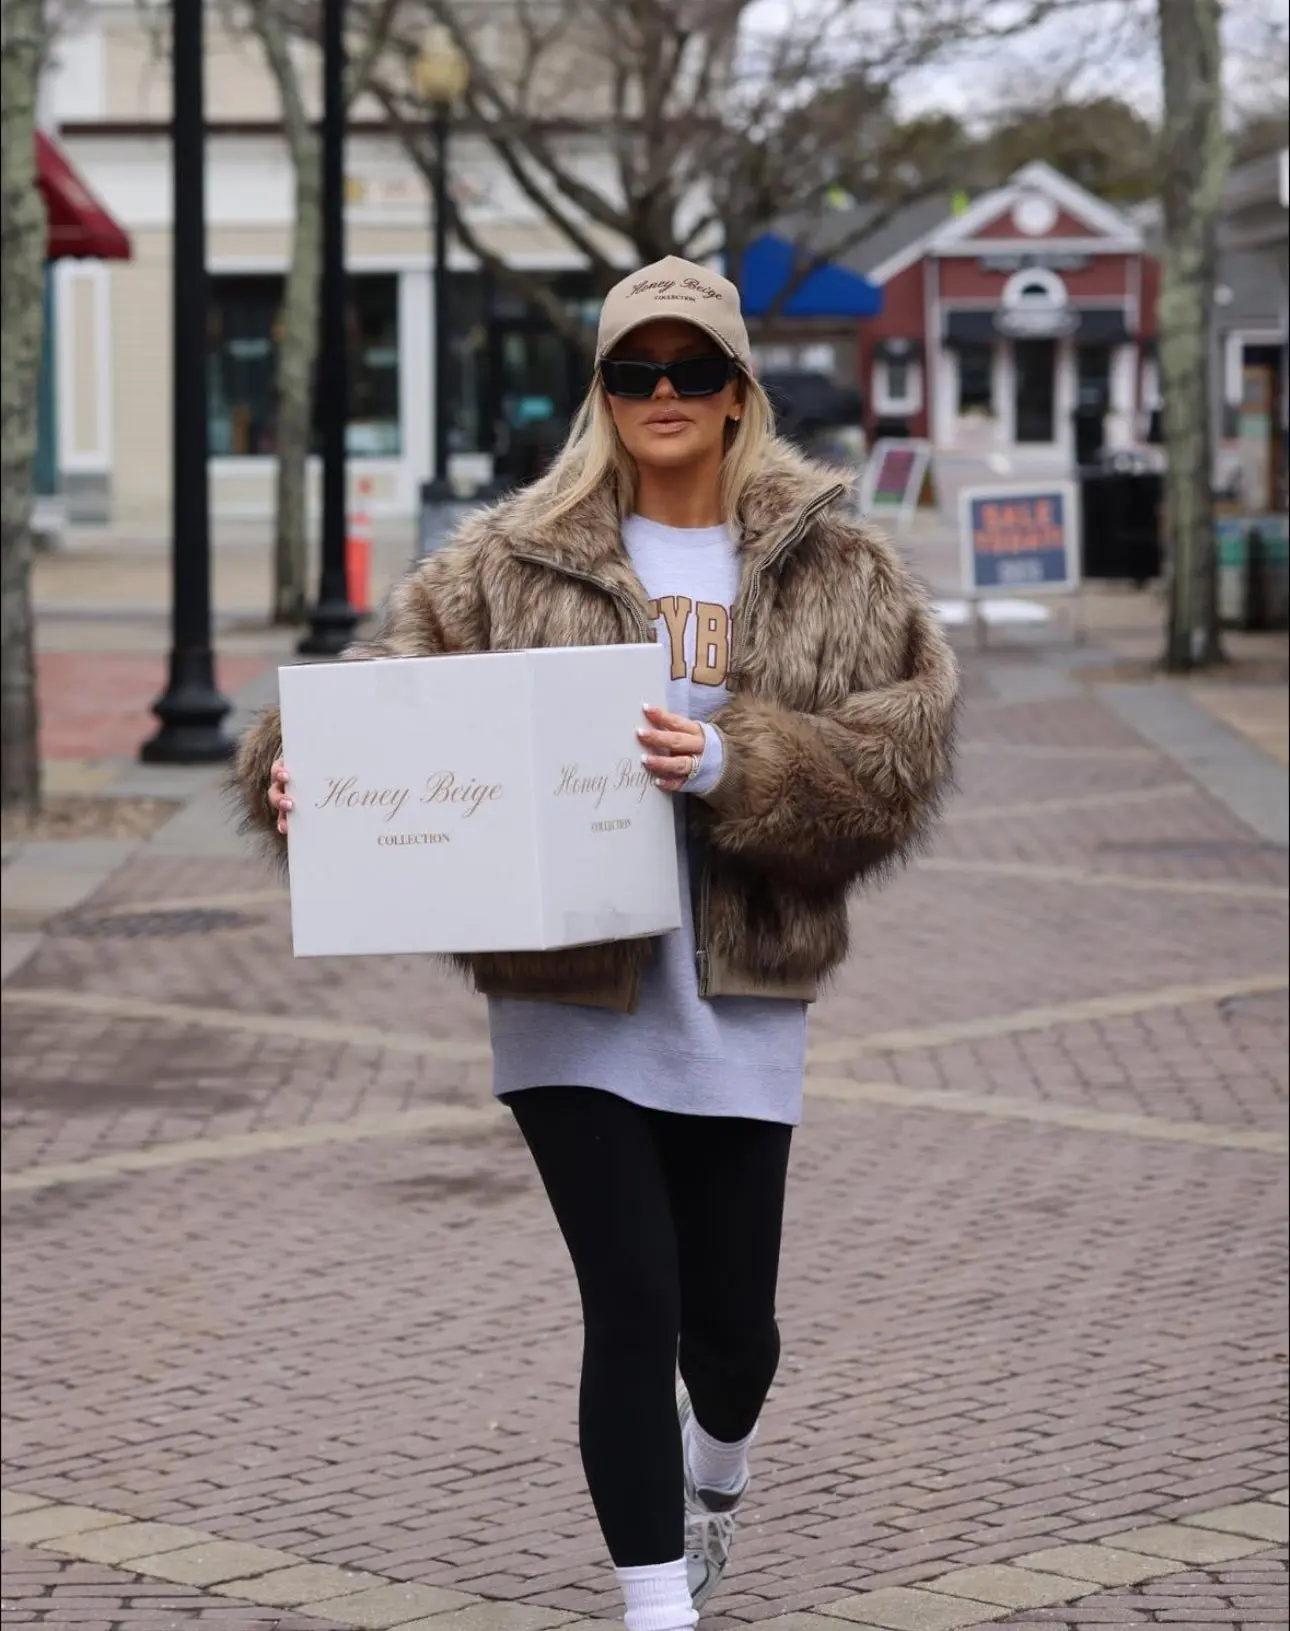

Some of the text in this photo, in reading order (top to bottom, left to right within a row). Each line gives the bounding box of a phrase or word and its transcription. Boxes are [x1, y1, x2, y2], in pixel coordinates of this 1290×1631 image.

[626, 278, 724, 301] Honey Beige
[654, 294, 696, 302] COLLECTION
[553, 762, 608, 810] Honey
[315, 770, 504, 822] Honey Beige
[591, 819, 632, 832] COLLECTION
[377, 832, 451, 846] COLLECTION
